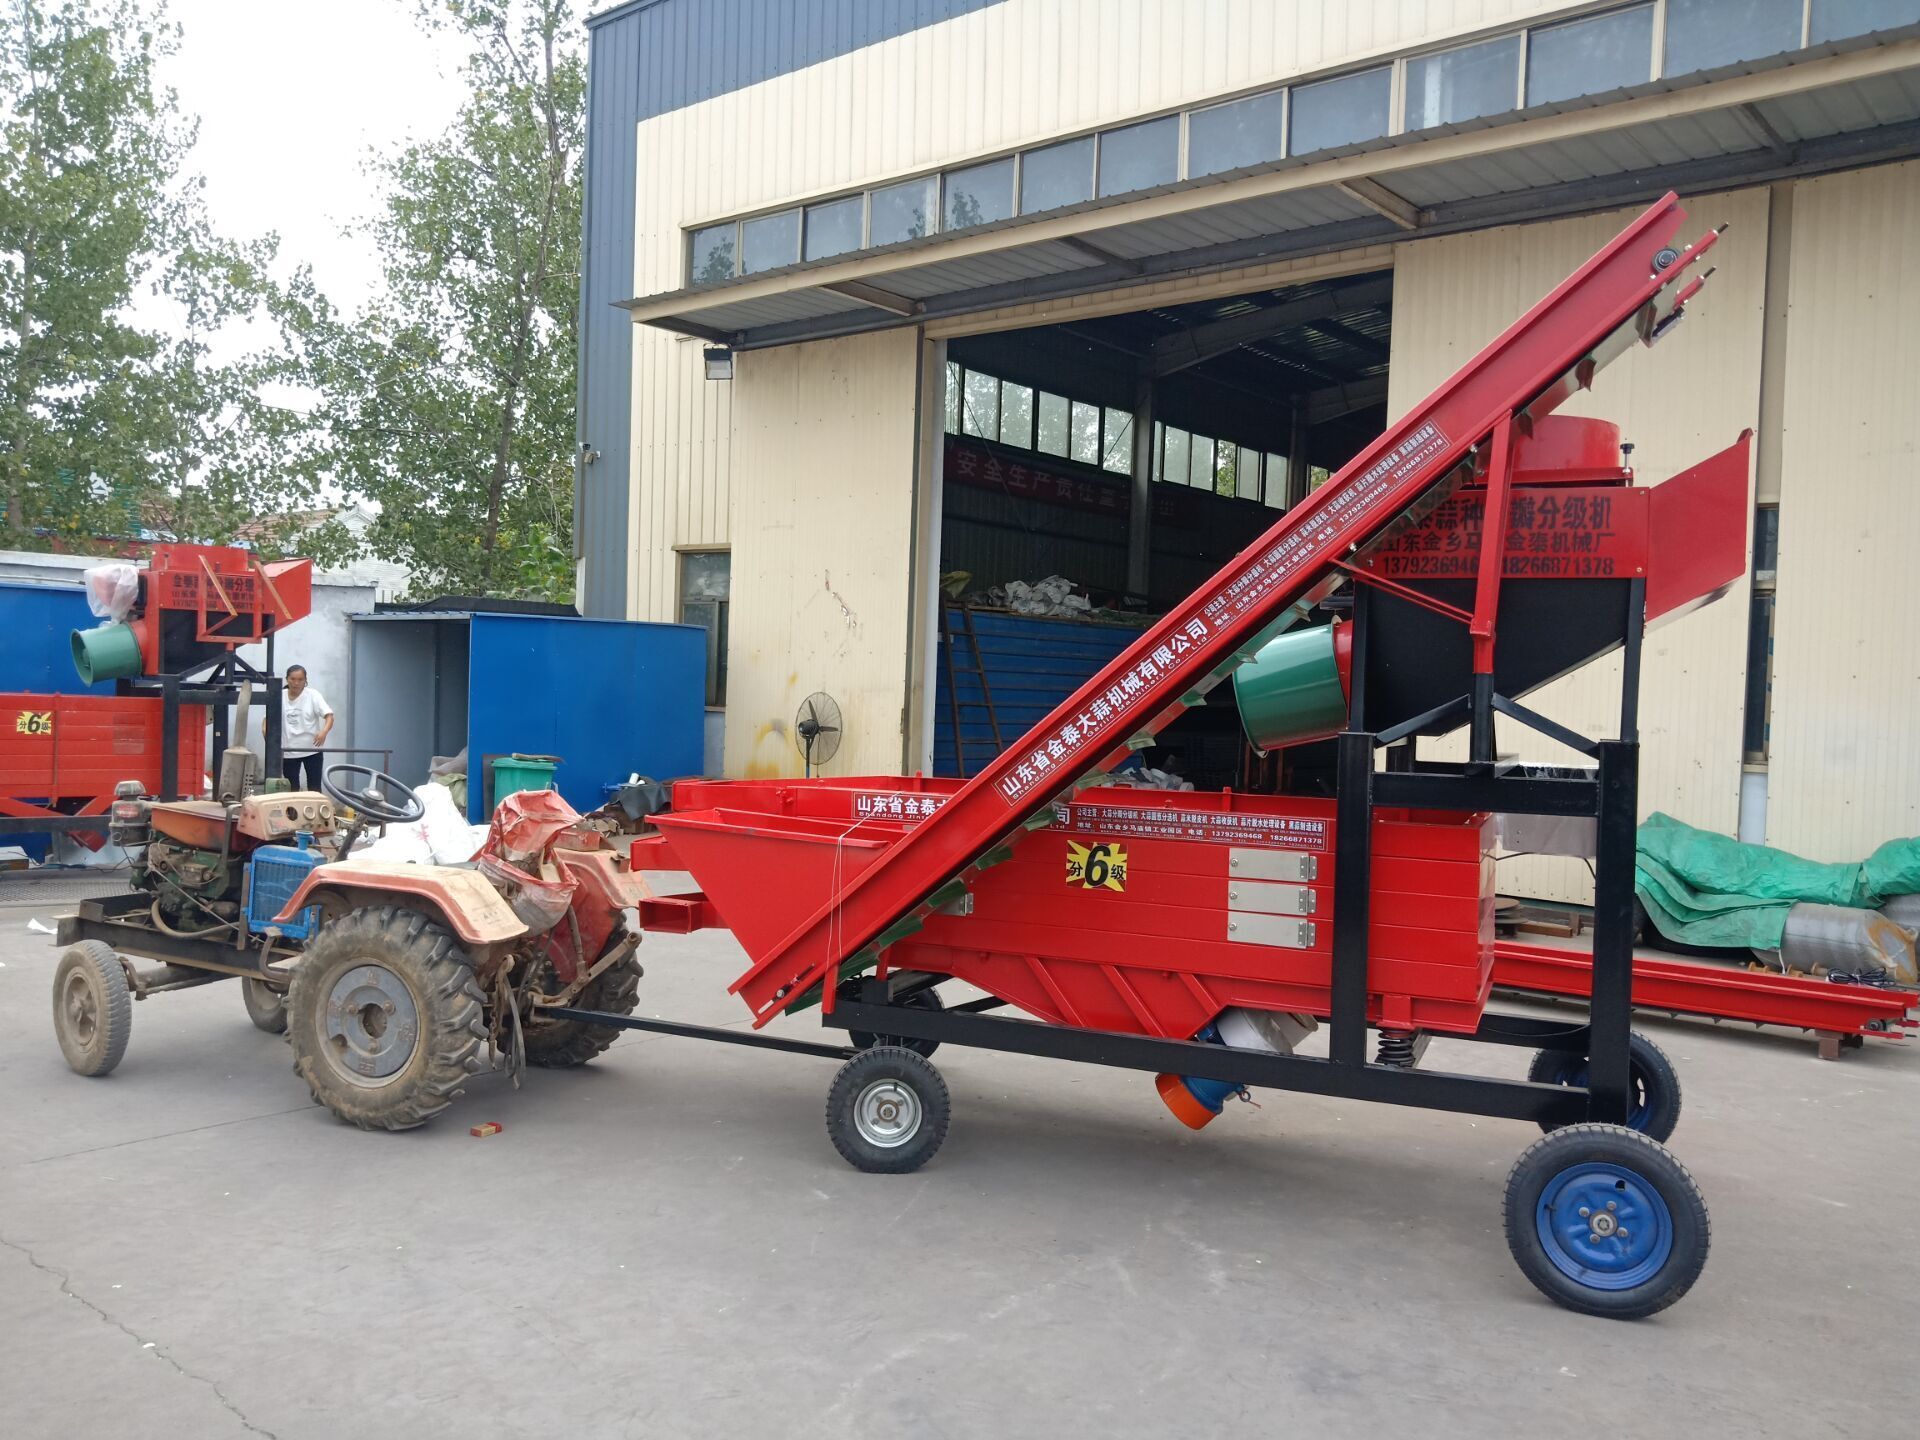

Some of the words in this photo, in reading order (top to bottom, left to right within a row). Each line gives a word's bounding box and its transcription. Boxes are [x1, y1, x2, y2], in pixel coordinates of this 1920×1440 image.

[1339, 482, 1388, 523] 13792369468
[1392, 438, 1443, 479] 18266871378
[1002, 617, 1208, 796] 山东省金泰大蒜机械有限公司
[1013, 763, 1056, 799] Shandong
[1059, 739, 1085, 761] Jintai
[1087, 714, 1115, 737] Garlic
[1117, 671, 1165, 712] Machinery
[1212, 830, 1263, 840] 13792369468
